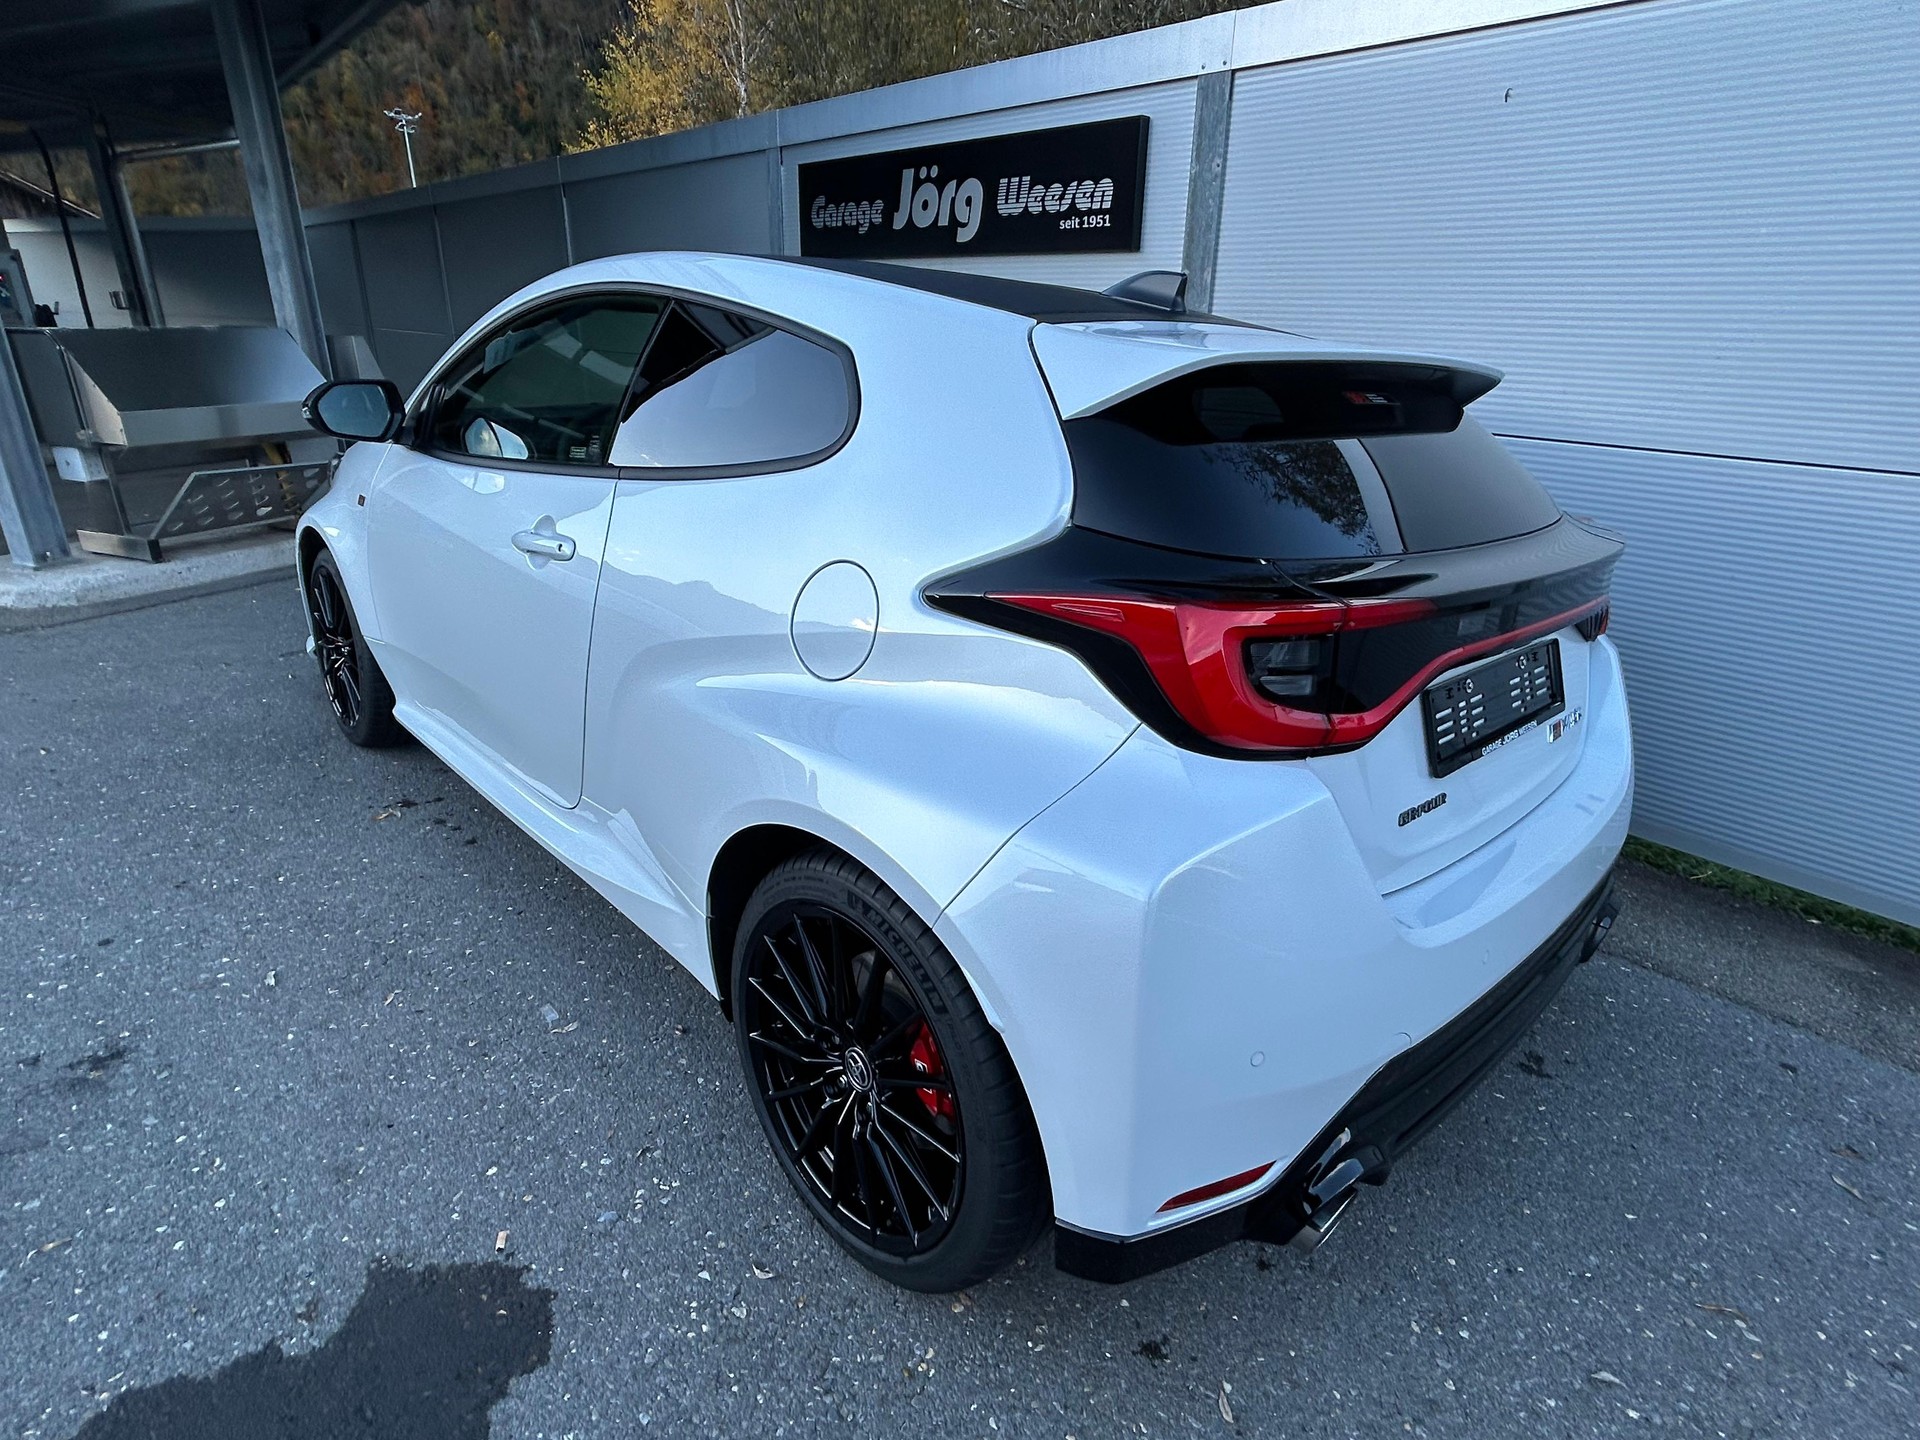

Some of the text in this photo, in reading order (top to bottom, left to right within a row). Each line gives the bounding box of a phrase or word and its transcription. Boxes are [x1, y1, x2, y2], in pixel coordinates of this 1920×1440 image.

[811, 164, 1114, 243] Garage Jörg Weesen
[1059, 214, 1111, 229] seit 1951
[865, 909, 949, 1013] MICHELIN
